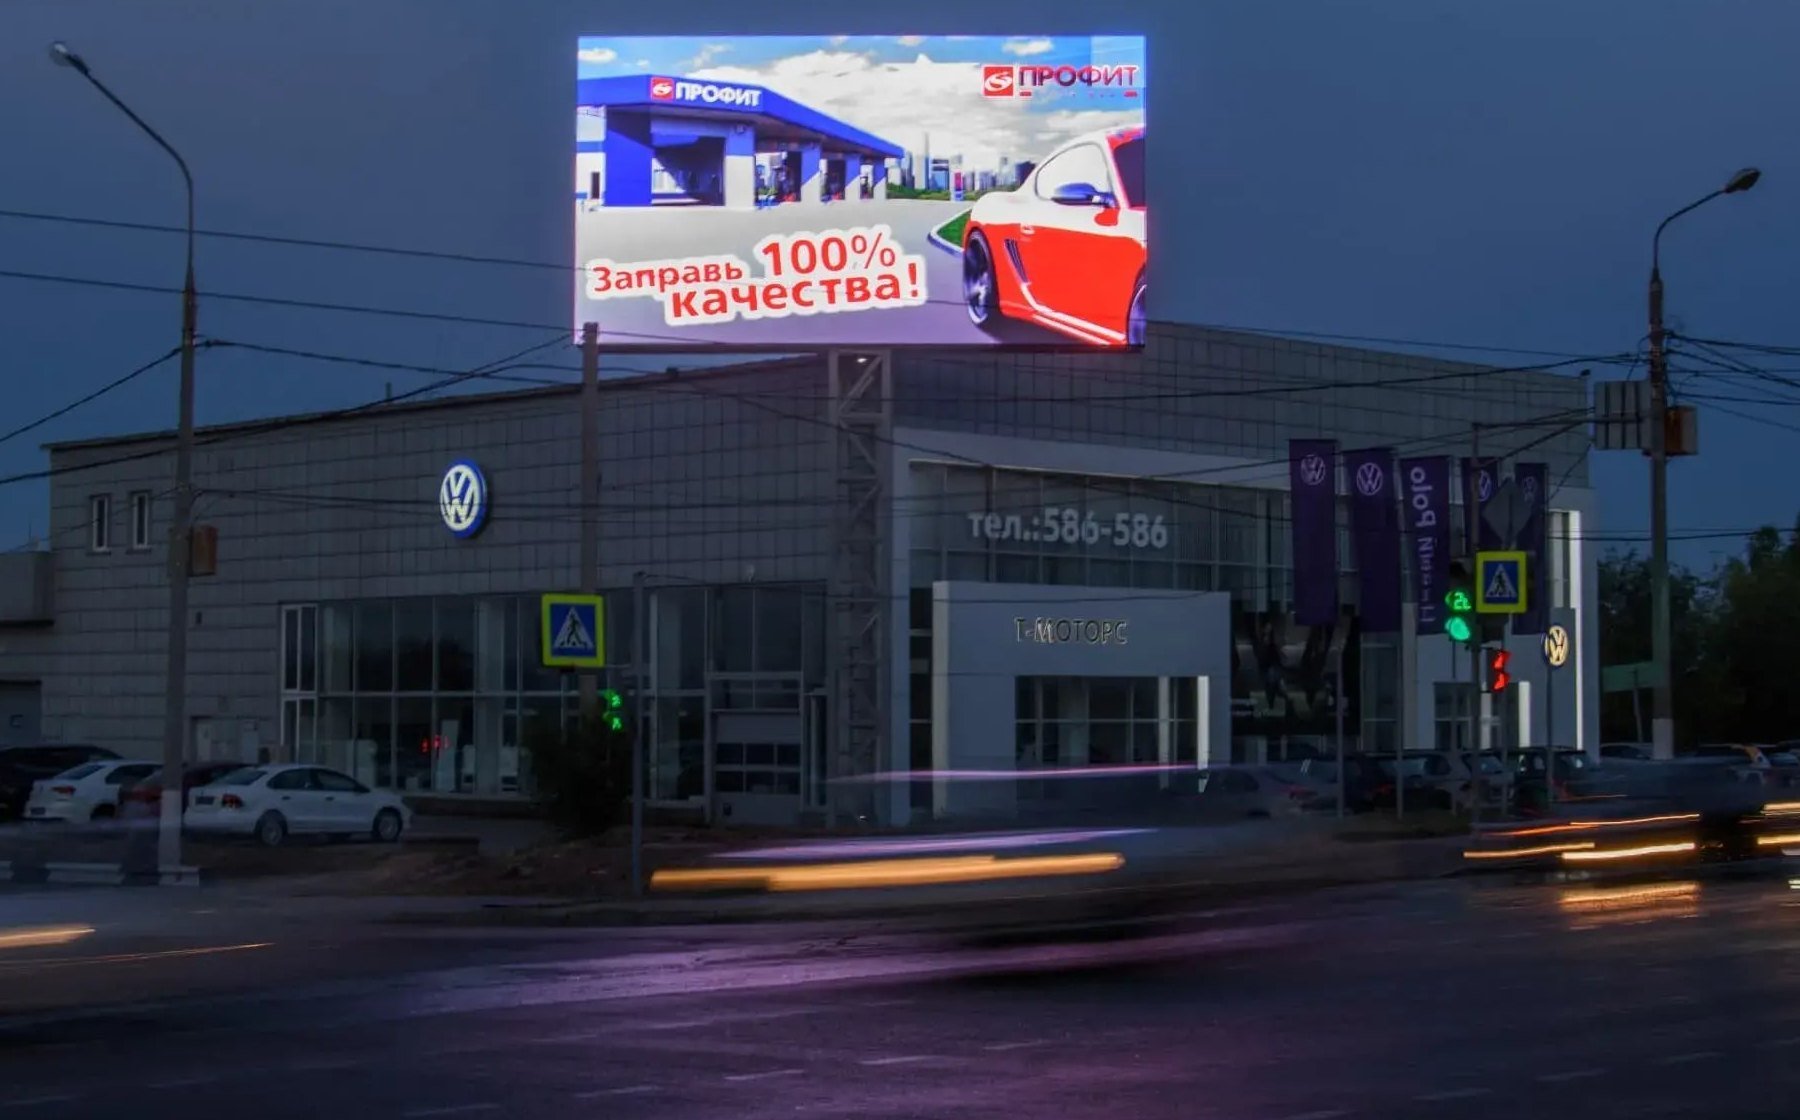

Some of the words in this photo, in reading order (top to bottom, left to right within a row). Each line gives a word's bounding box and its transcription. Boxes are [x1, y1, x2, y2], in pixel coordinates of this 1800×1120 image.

[1019, 64, 1138, 87] ПРОФИТ
[675, 82, 762, 107] ПРОФИТ
[592, 261, 744, 293] Заправь
[761, 231, 896, 277] 100%
[670, 261, 919, 318] качества!
[1014, 617, 1128, 645] Т-МОТОРС
